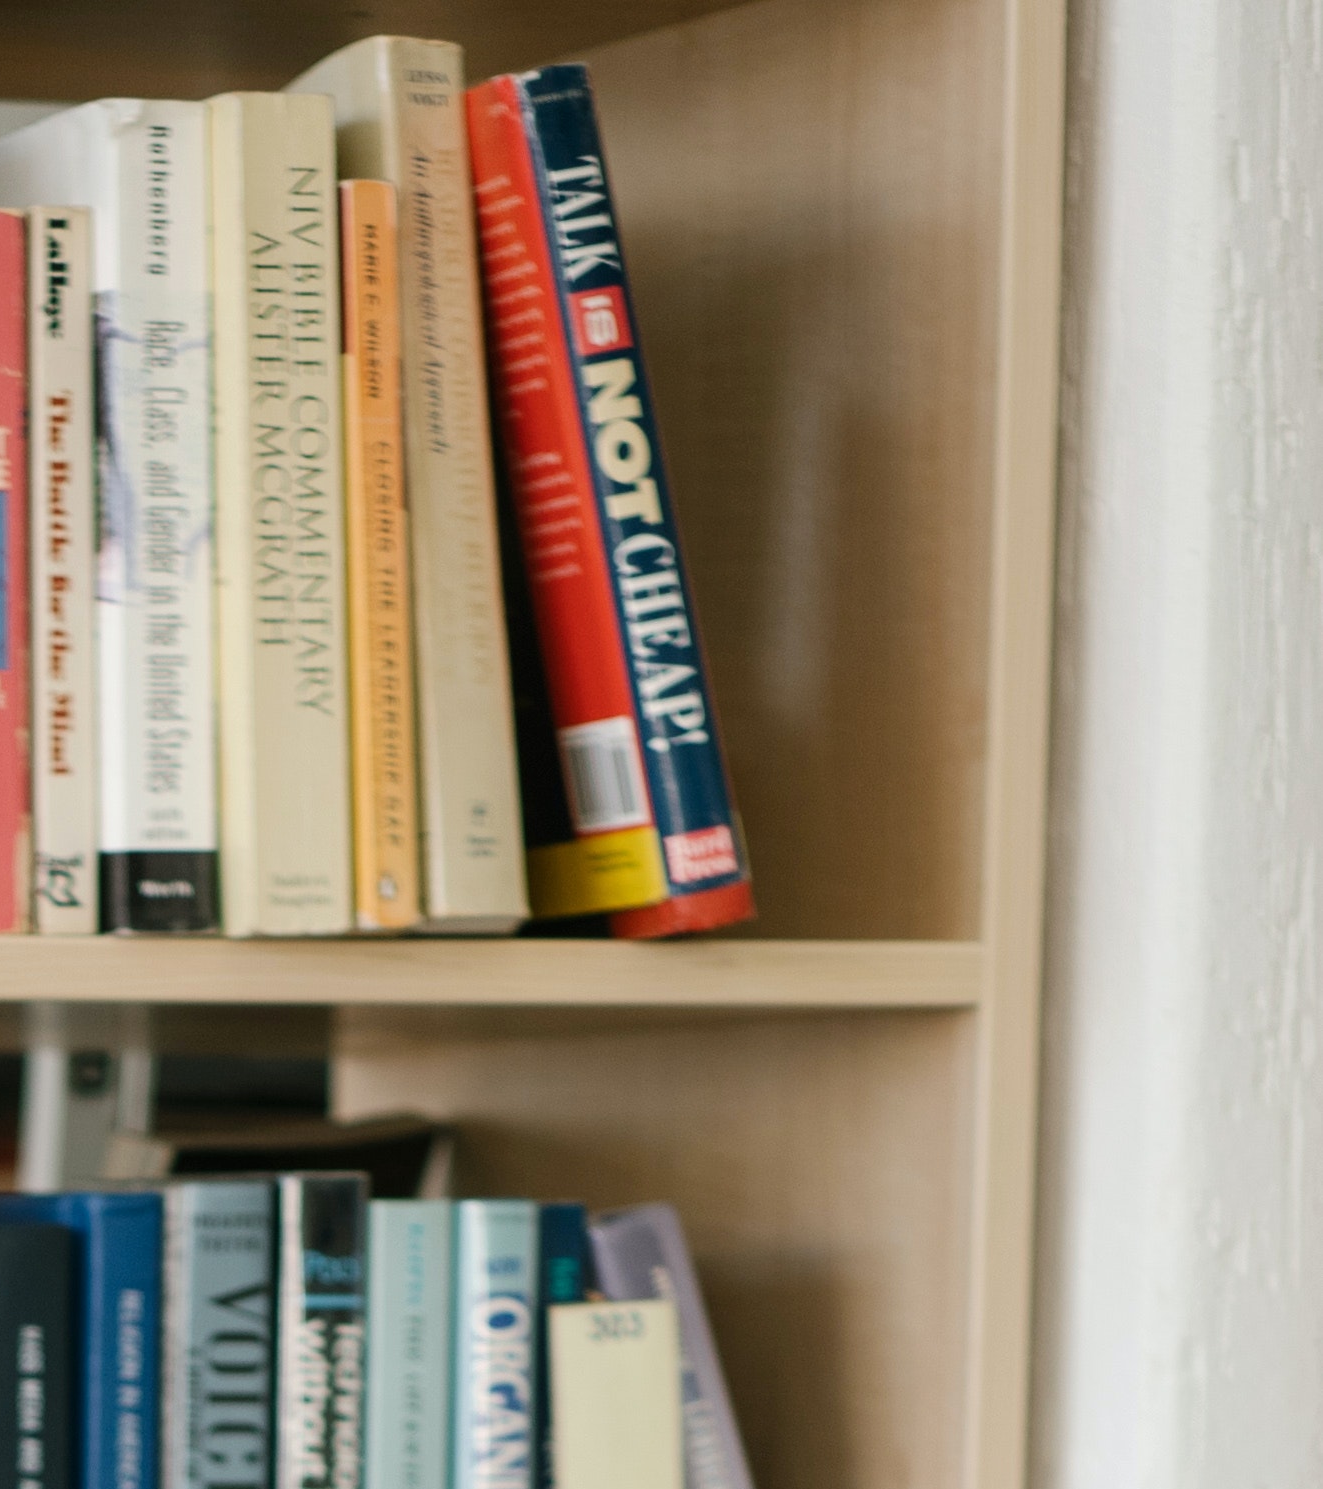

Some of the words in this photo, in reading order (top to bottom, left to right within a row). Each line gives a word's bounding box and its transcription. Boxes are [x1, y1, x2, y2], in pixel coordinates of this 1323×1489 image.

[288, 164, 328, 252] NIV
[546, 156, 622, 283] TALK
[139, 319, 188, 376] Race,
[249, 230, 295, 402] ALISTER
[289, 261, 328, 376] BIBLE
[139, 387, 190, 450] Class,
[579, 357, 663, 526] NOT
[142, 459, 189, 501] and
[142, 504, 189, 576] Gender
[289, 393, 337, 717] COMMENTARY
[142, 612, 189, 648] the
[612, 532, 710, 754] CHEAP!
[142, 651, 190, 722] United
[142, 727, 190, 796] States
